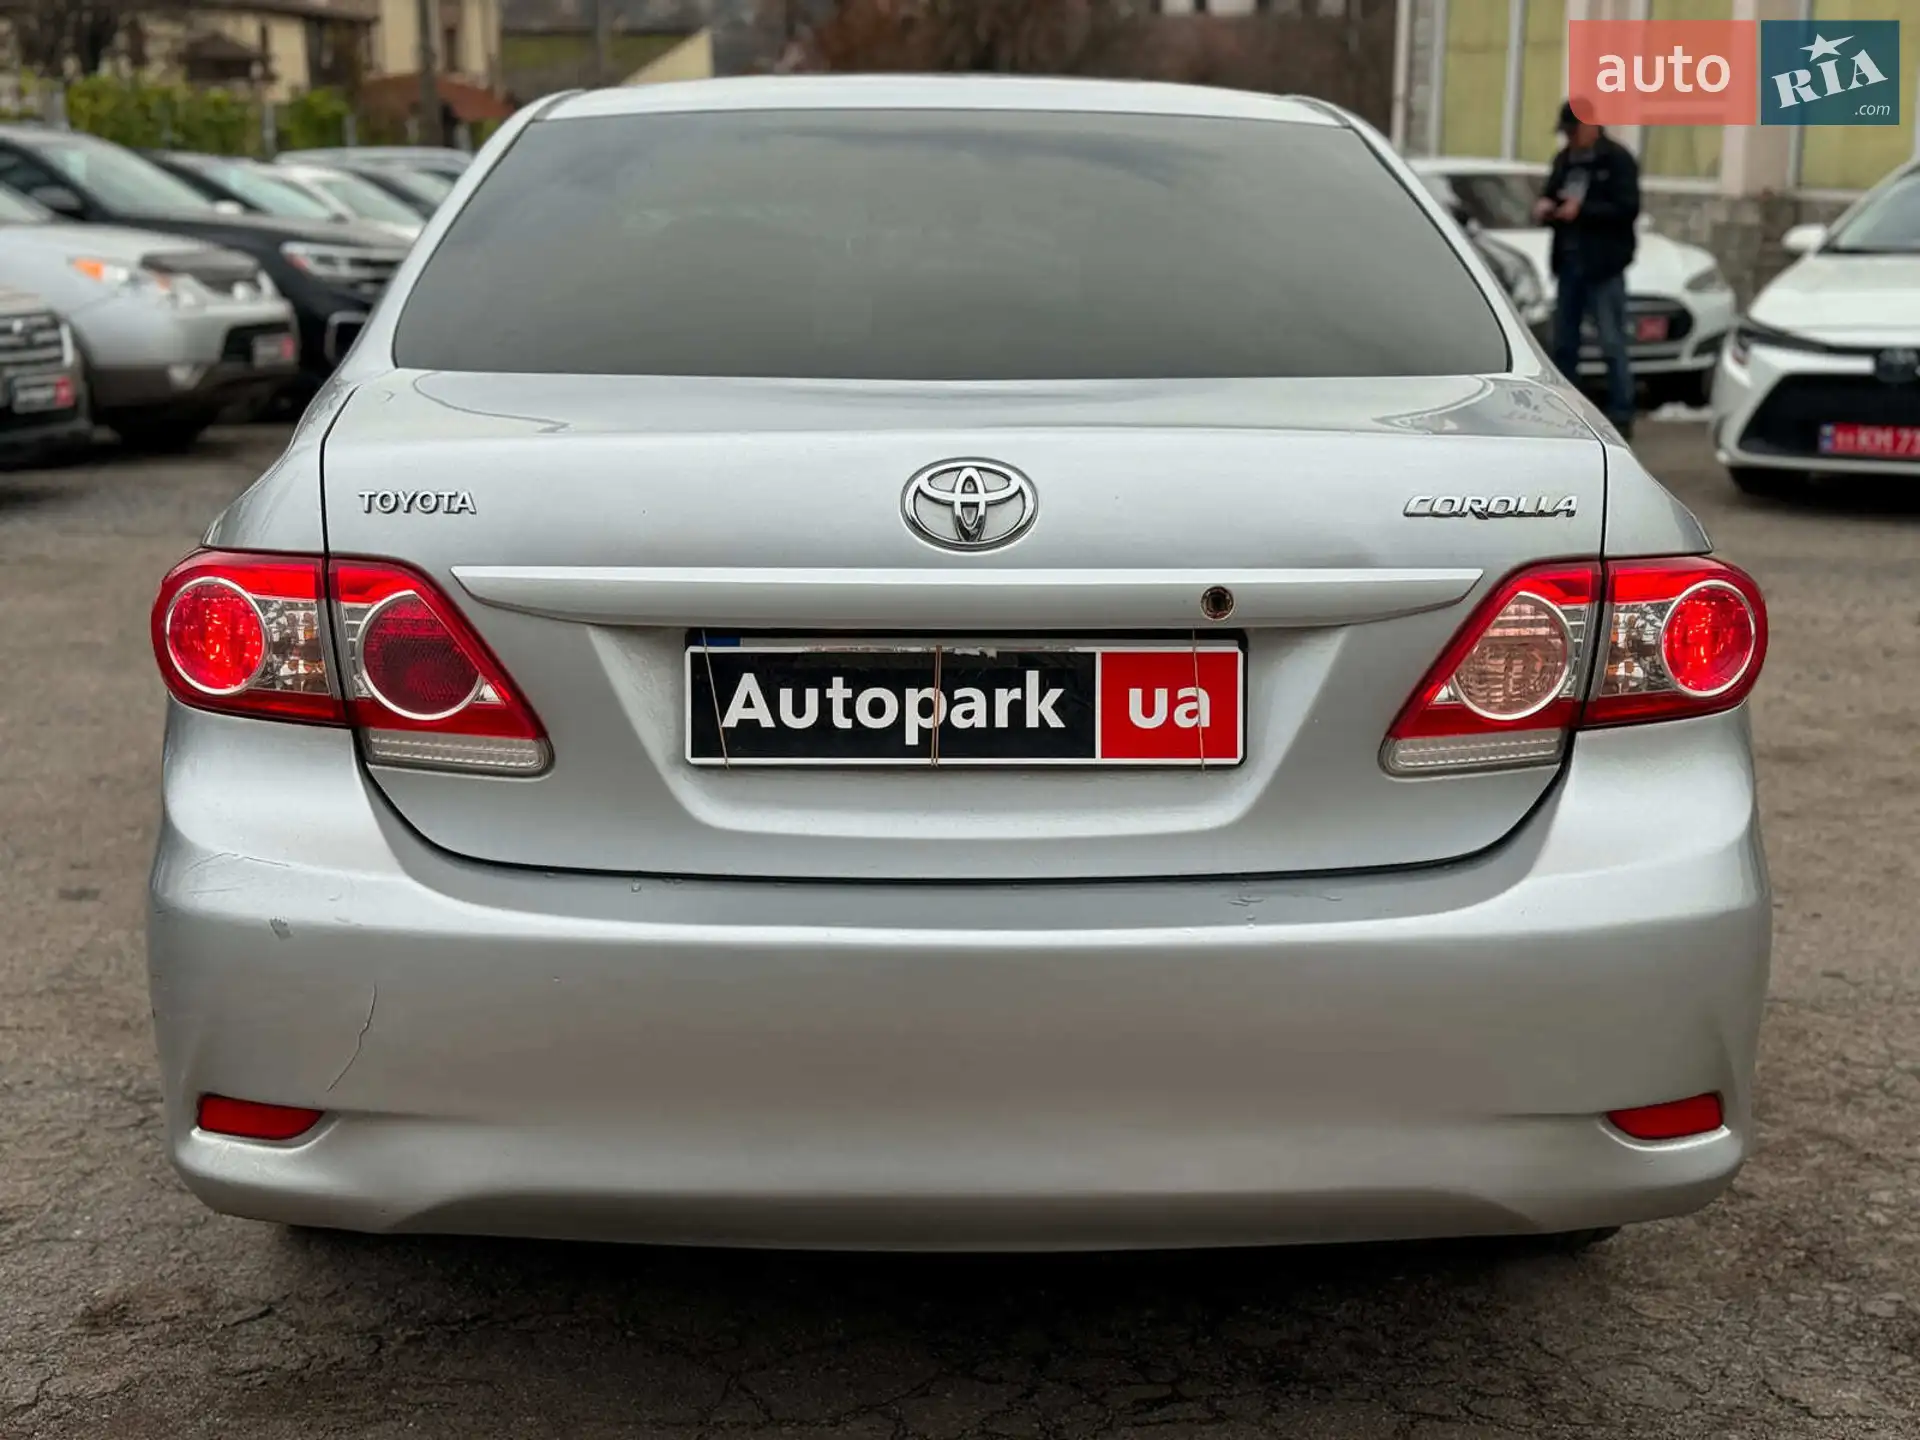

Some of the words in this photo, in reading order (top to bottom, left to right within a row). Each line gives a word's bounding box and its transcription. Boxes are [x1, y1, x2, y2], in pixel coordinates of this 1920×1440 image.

[358, 490, 477, 515] TOYOTA
[1402, 495, 1577, 520] COROLLA
[721, 671, 1066, 745] Autopark
[1127, 686, 1211, 728] ua
